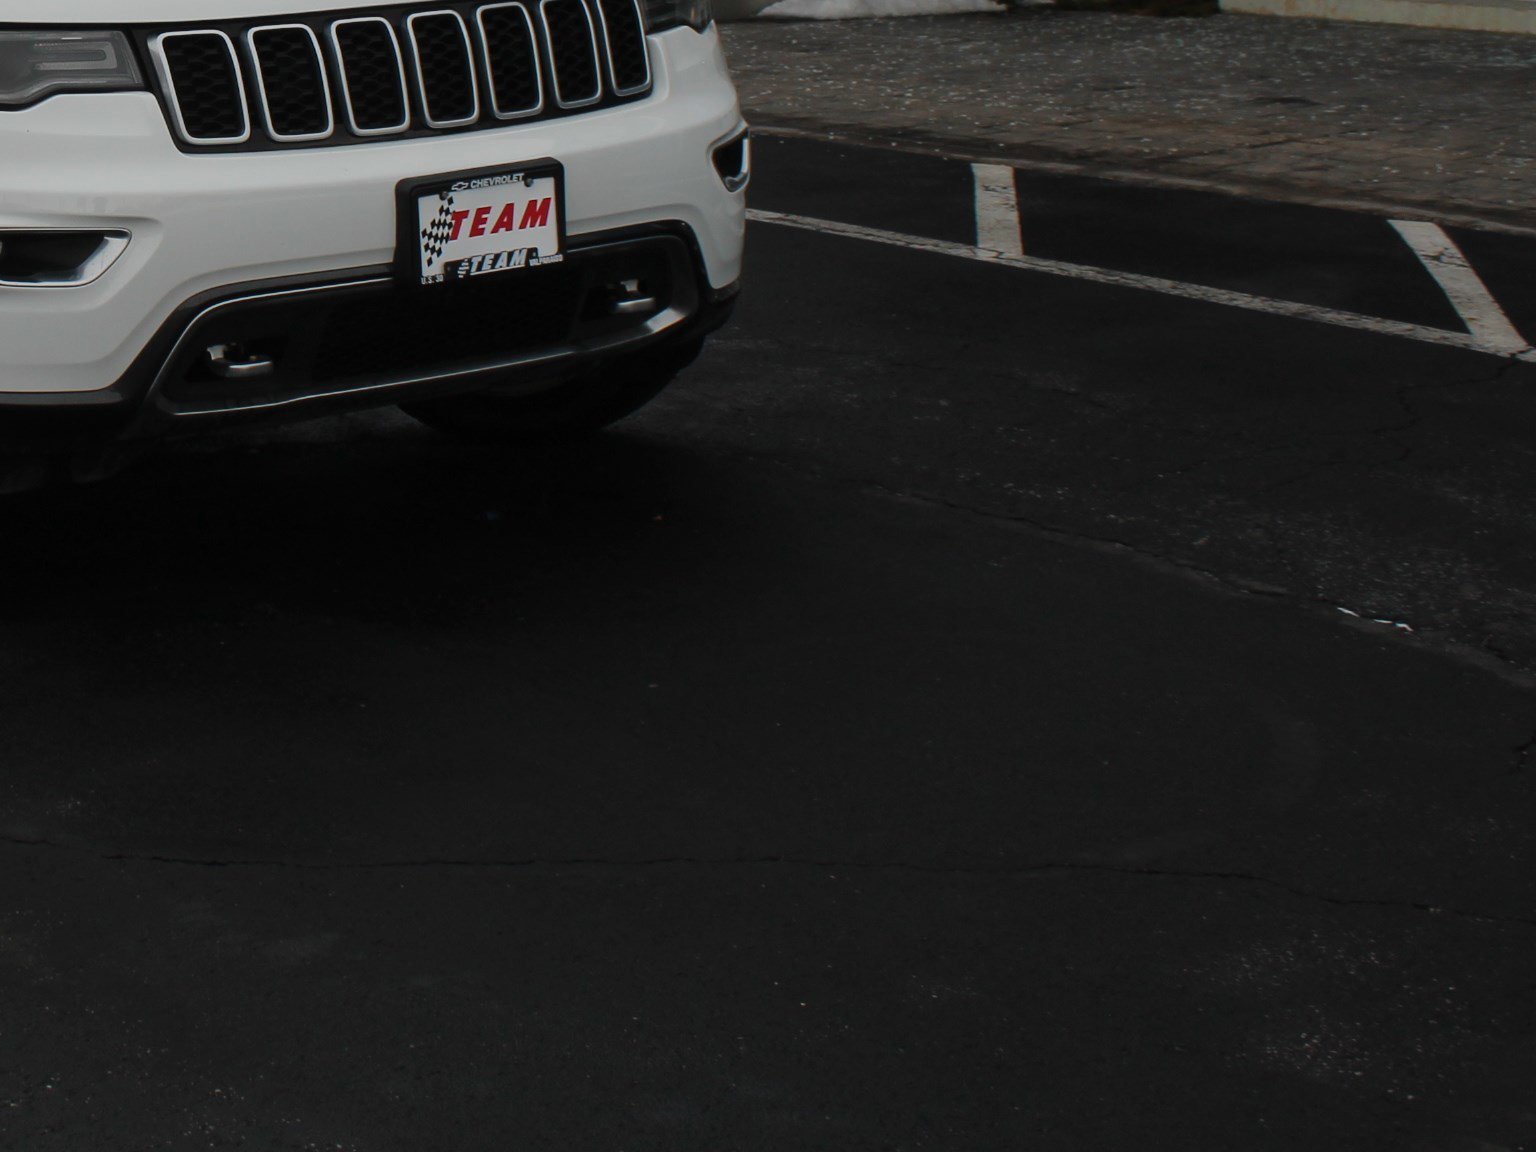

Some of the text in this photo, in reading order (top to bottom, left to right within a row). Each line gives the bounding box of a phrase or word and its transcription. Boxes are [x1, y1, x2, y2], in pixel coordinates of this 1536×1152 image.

[470, 173, 525, 189] CHEVROLET
[449, 197, 552, 241] TEAM
[469, 248, 528, 274] TEAM
